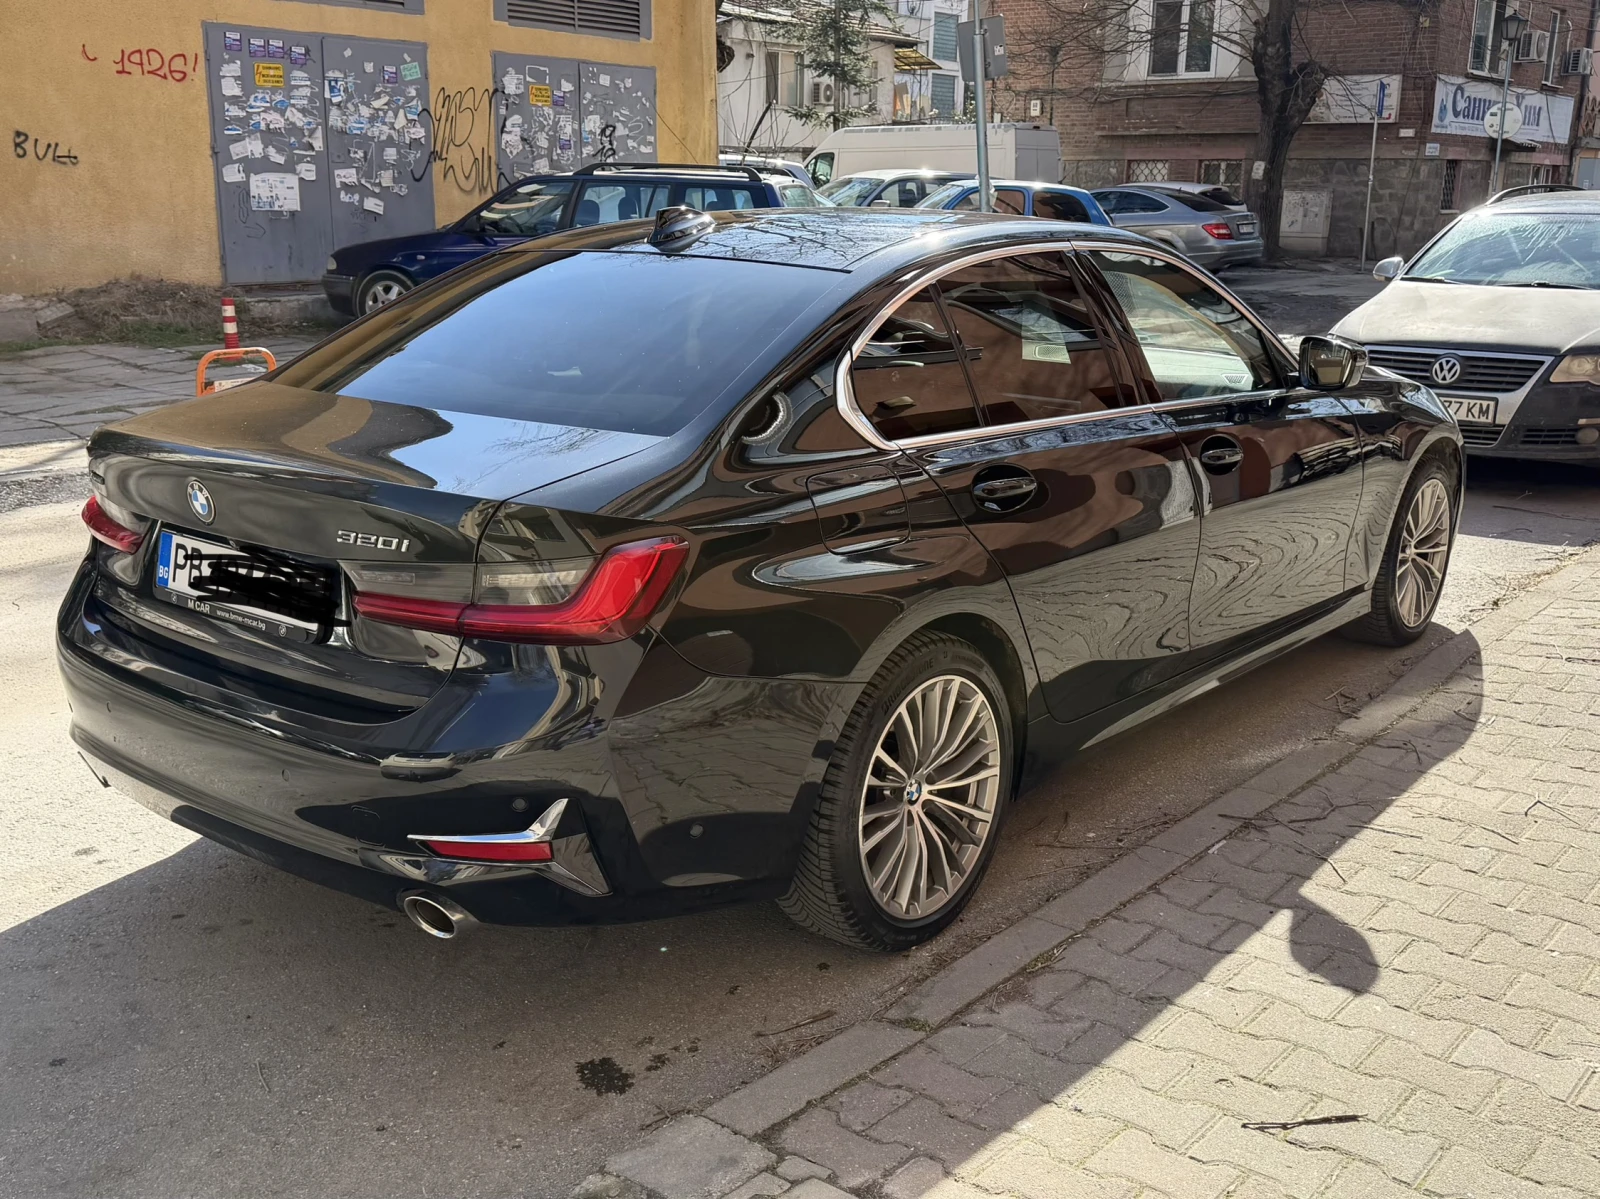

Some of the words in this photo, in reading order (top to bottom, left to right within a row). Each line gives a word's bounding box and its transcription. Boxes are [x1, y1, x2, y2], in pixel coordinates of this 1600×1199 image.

[1466, 402, 1490, 419] KM
[336, 530, 410, 552] 320i
[158, 564, 169, 579] BG
[187, 598, 195, 609] M
[195, 601, 211, 615] CAR
